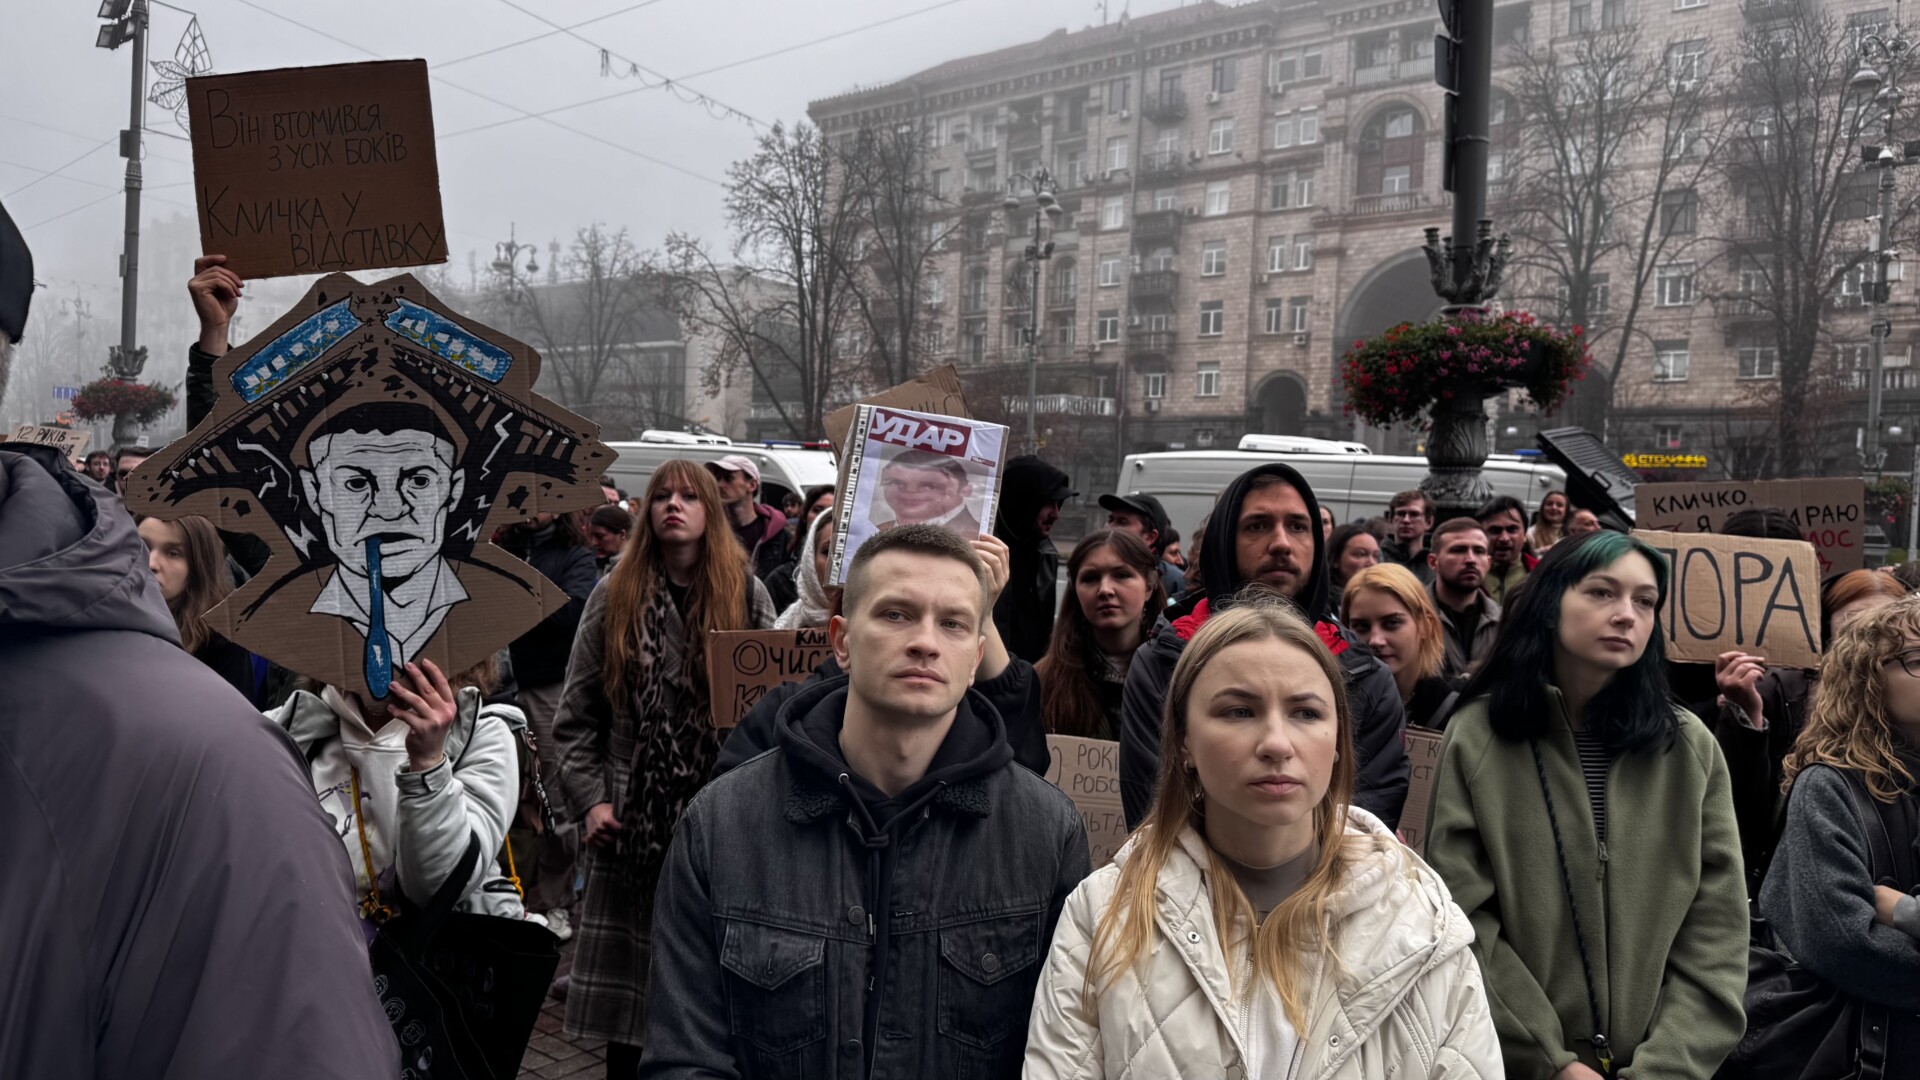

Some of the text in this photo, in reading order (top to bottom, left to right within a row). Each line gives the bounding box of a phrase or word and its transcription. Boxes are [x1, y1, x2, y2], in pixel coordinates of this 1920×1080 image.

[206, 89, 262, 149] Він
[267, 145, 282, 171] З
[286, 140, 333, 169] УСІХ
[341, 190, 362, 227] У
[290, 219, 444, 271] ВІДСТАВКУ
[16, 426, 34, 440] 12
[870, 412, 965, 452] УДАР
[1652, 489, 1754, 516] КЛИЧКО,
[1697, 514, 1712, 533] Я
